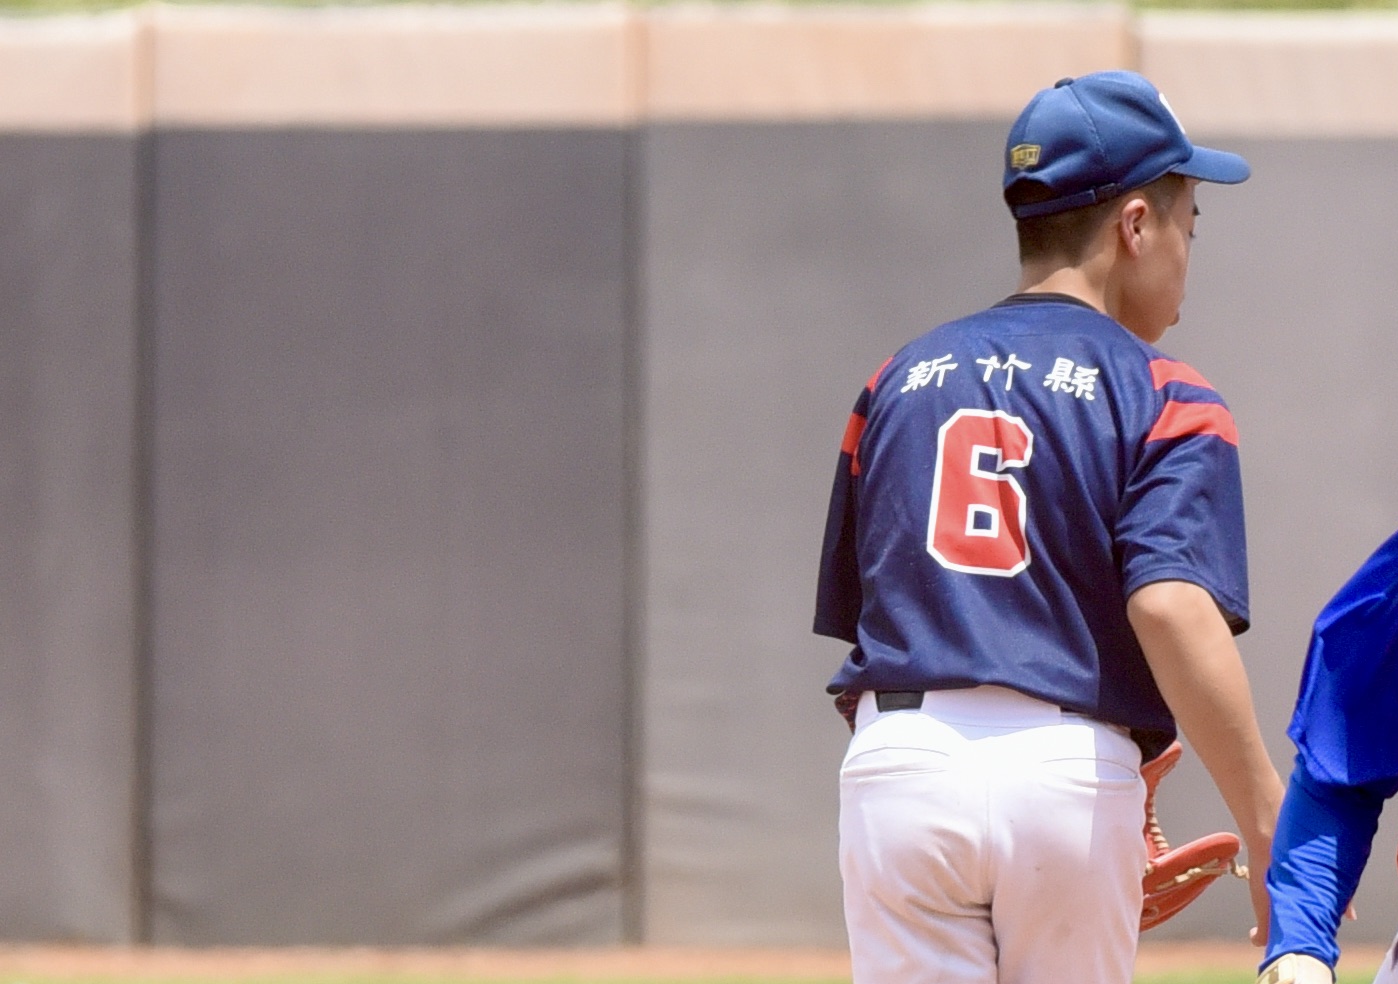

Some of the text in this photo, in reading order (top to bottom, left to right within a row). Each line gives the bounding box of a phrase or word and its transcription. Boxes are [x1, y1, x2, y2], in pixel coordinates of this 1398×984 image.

[900, 353, 1100, 400] 新竹縣
[926, 408, 1034, 577] 6
